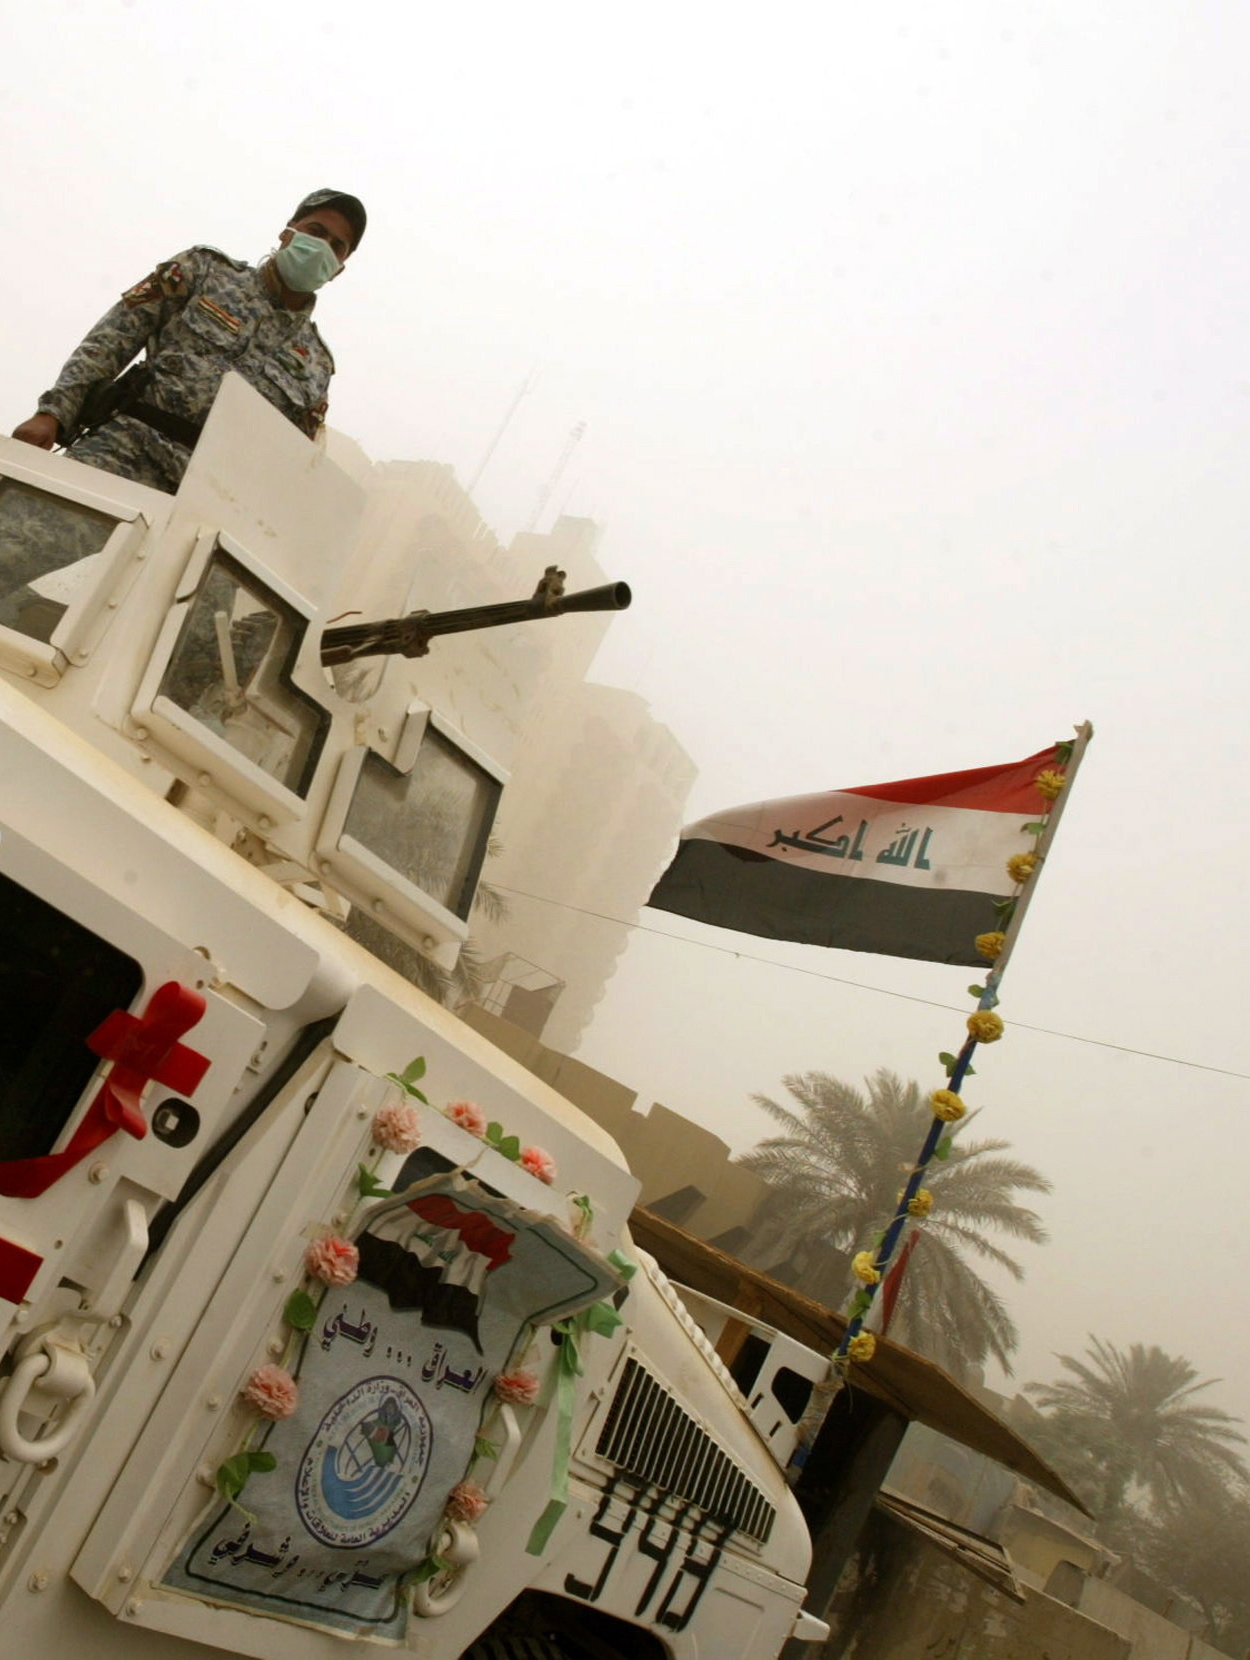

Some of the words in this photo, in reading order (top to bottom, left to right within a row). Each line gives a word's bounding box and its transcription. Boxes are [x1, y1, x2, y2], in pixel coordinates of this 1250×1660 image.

[876, 822, 934, 870] الله
[321, 1303, 378, 1358] وطني
[421, 1341, 490, 1394] العراق
